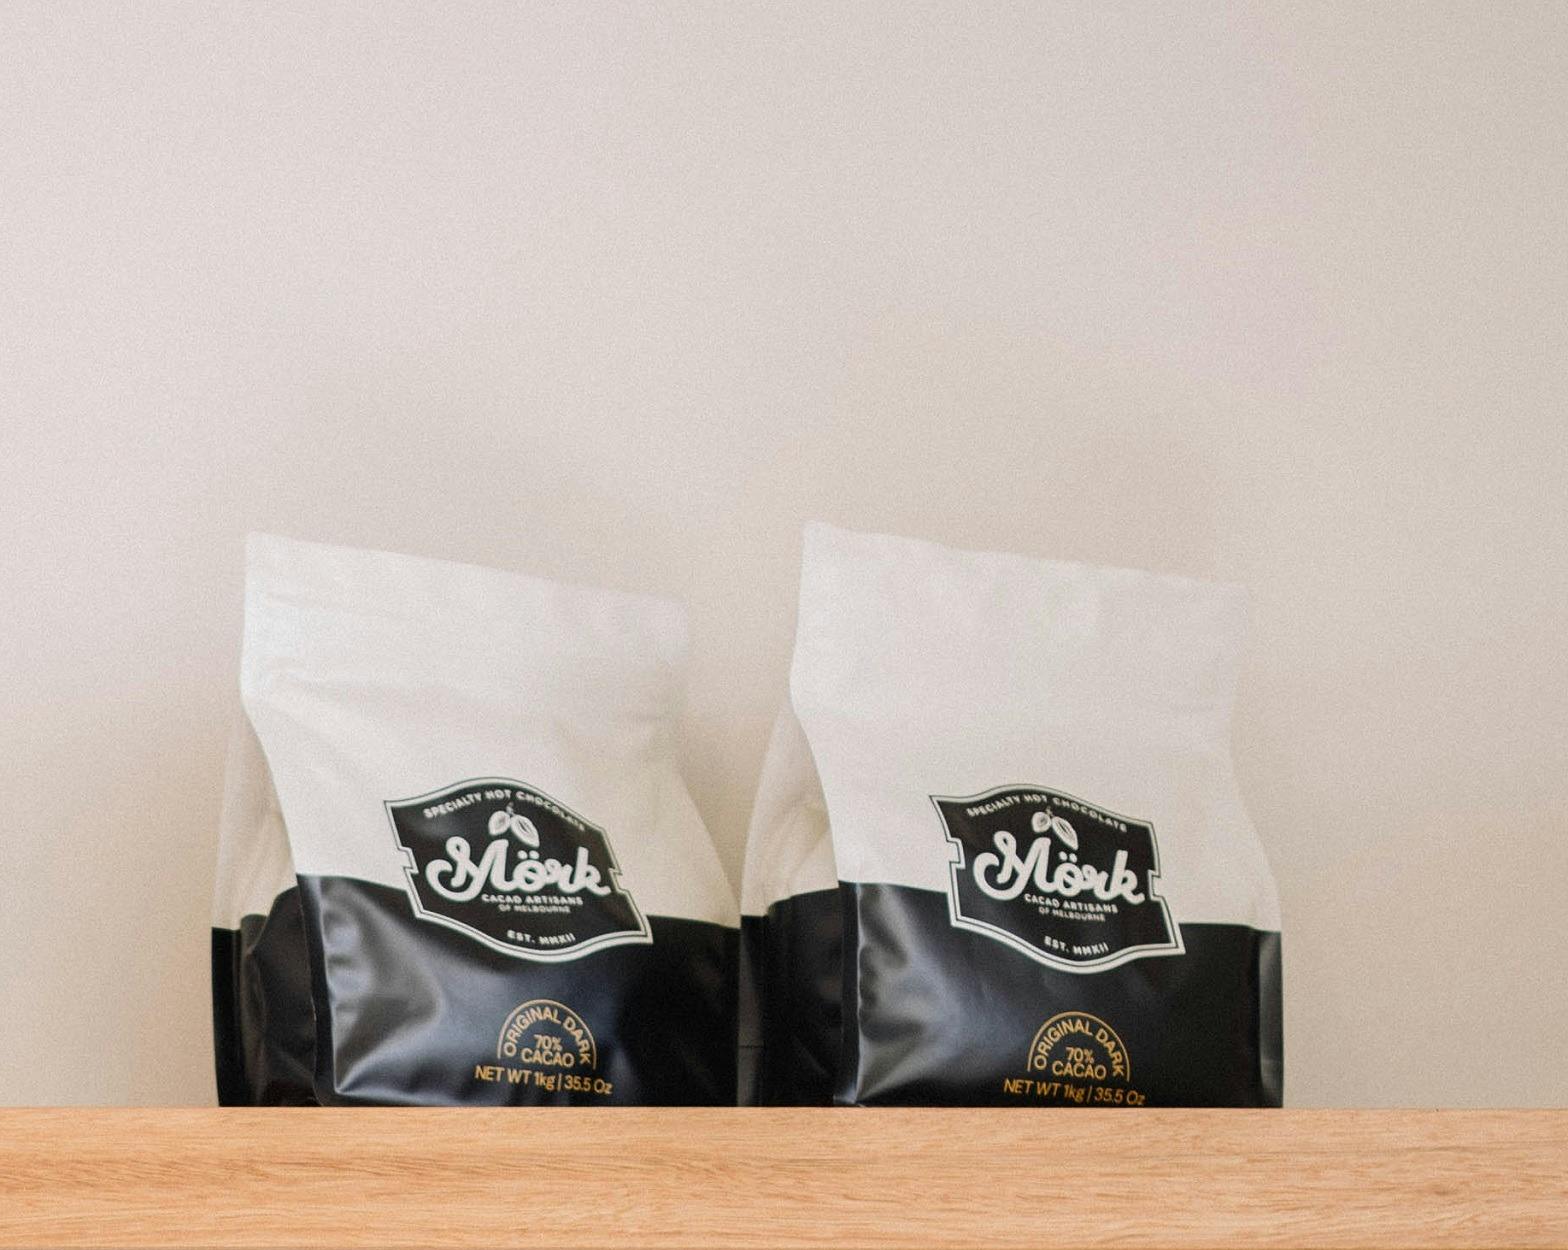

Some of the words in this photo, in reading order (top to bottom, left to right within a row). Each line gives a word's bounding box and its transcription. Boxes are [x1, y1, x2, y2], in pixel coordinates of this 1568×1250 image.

[423, 792, 482, 819] SPECIALTY
[485, 789, 512, 800] HOT
[966, 795, 1021, 817] SPECIALTY
[1024, 793, 1048, 803] HOT
[1052, 797, 1127, 833] CHOCOLATE
[425, 836, 611, 902] Mörk
[973, 830, 1145, 905] Mörk
[482, 893, 523, 904] CACAO
[525, 895, 584, 906] ARTISANS
[498, 904, 511, 912] OF
[514, 905, 571, 913] MELBOURNE
[1024, 893, 1060, 908] CACAO
[1062, 901, 1118, 914] ARTISANS
[1038, 906, 1050, 915] OF
[1052, 908, 1106, 922] MELBOURNE
[507, 930, 535, 943] EST.
[539, 933, 576, 945] MMXII
[1044, 935, 1070, 953] EST.
[1073, 942, 1109, 956] MMXII
[503, 1006, 561, 1057] ORIGINAL
[563, 1016, 591, 1065] DARK
[534, 1034, 563, 1052] 70%
[520, 1047, 574, 1068] CACAO
[1034, 1018, 1093, 1070] ORIGINAL
[1095, 1028, 1125, 1077] DARK
[1065, 1046, 1095, 1064] 70%
[475, 1064, 505, 1082] NET
[507, 1068, 532, 1085] WT
[534, 1071, 555, 1091] 1kg
[564, 1074, 591, 1092] 35.5
[594, 1078, 614, 1094] Oz
[1052, 1060, 1107, 1080] CACAO
[1003, 1078, 1034, 1094] NET
[1036, 1081, 1061, 1097] WT
[1094, 1087, 1124, 1105] 35.5
[1126, 1090, 1146, 1106] Oz
